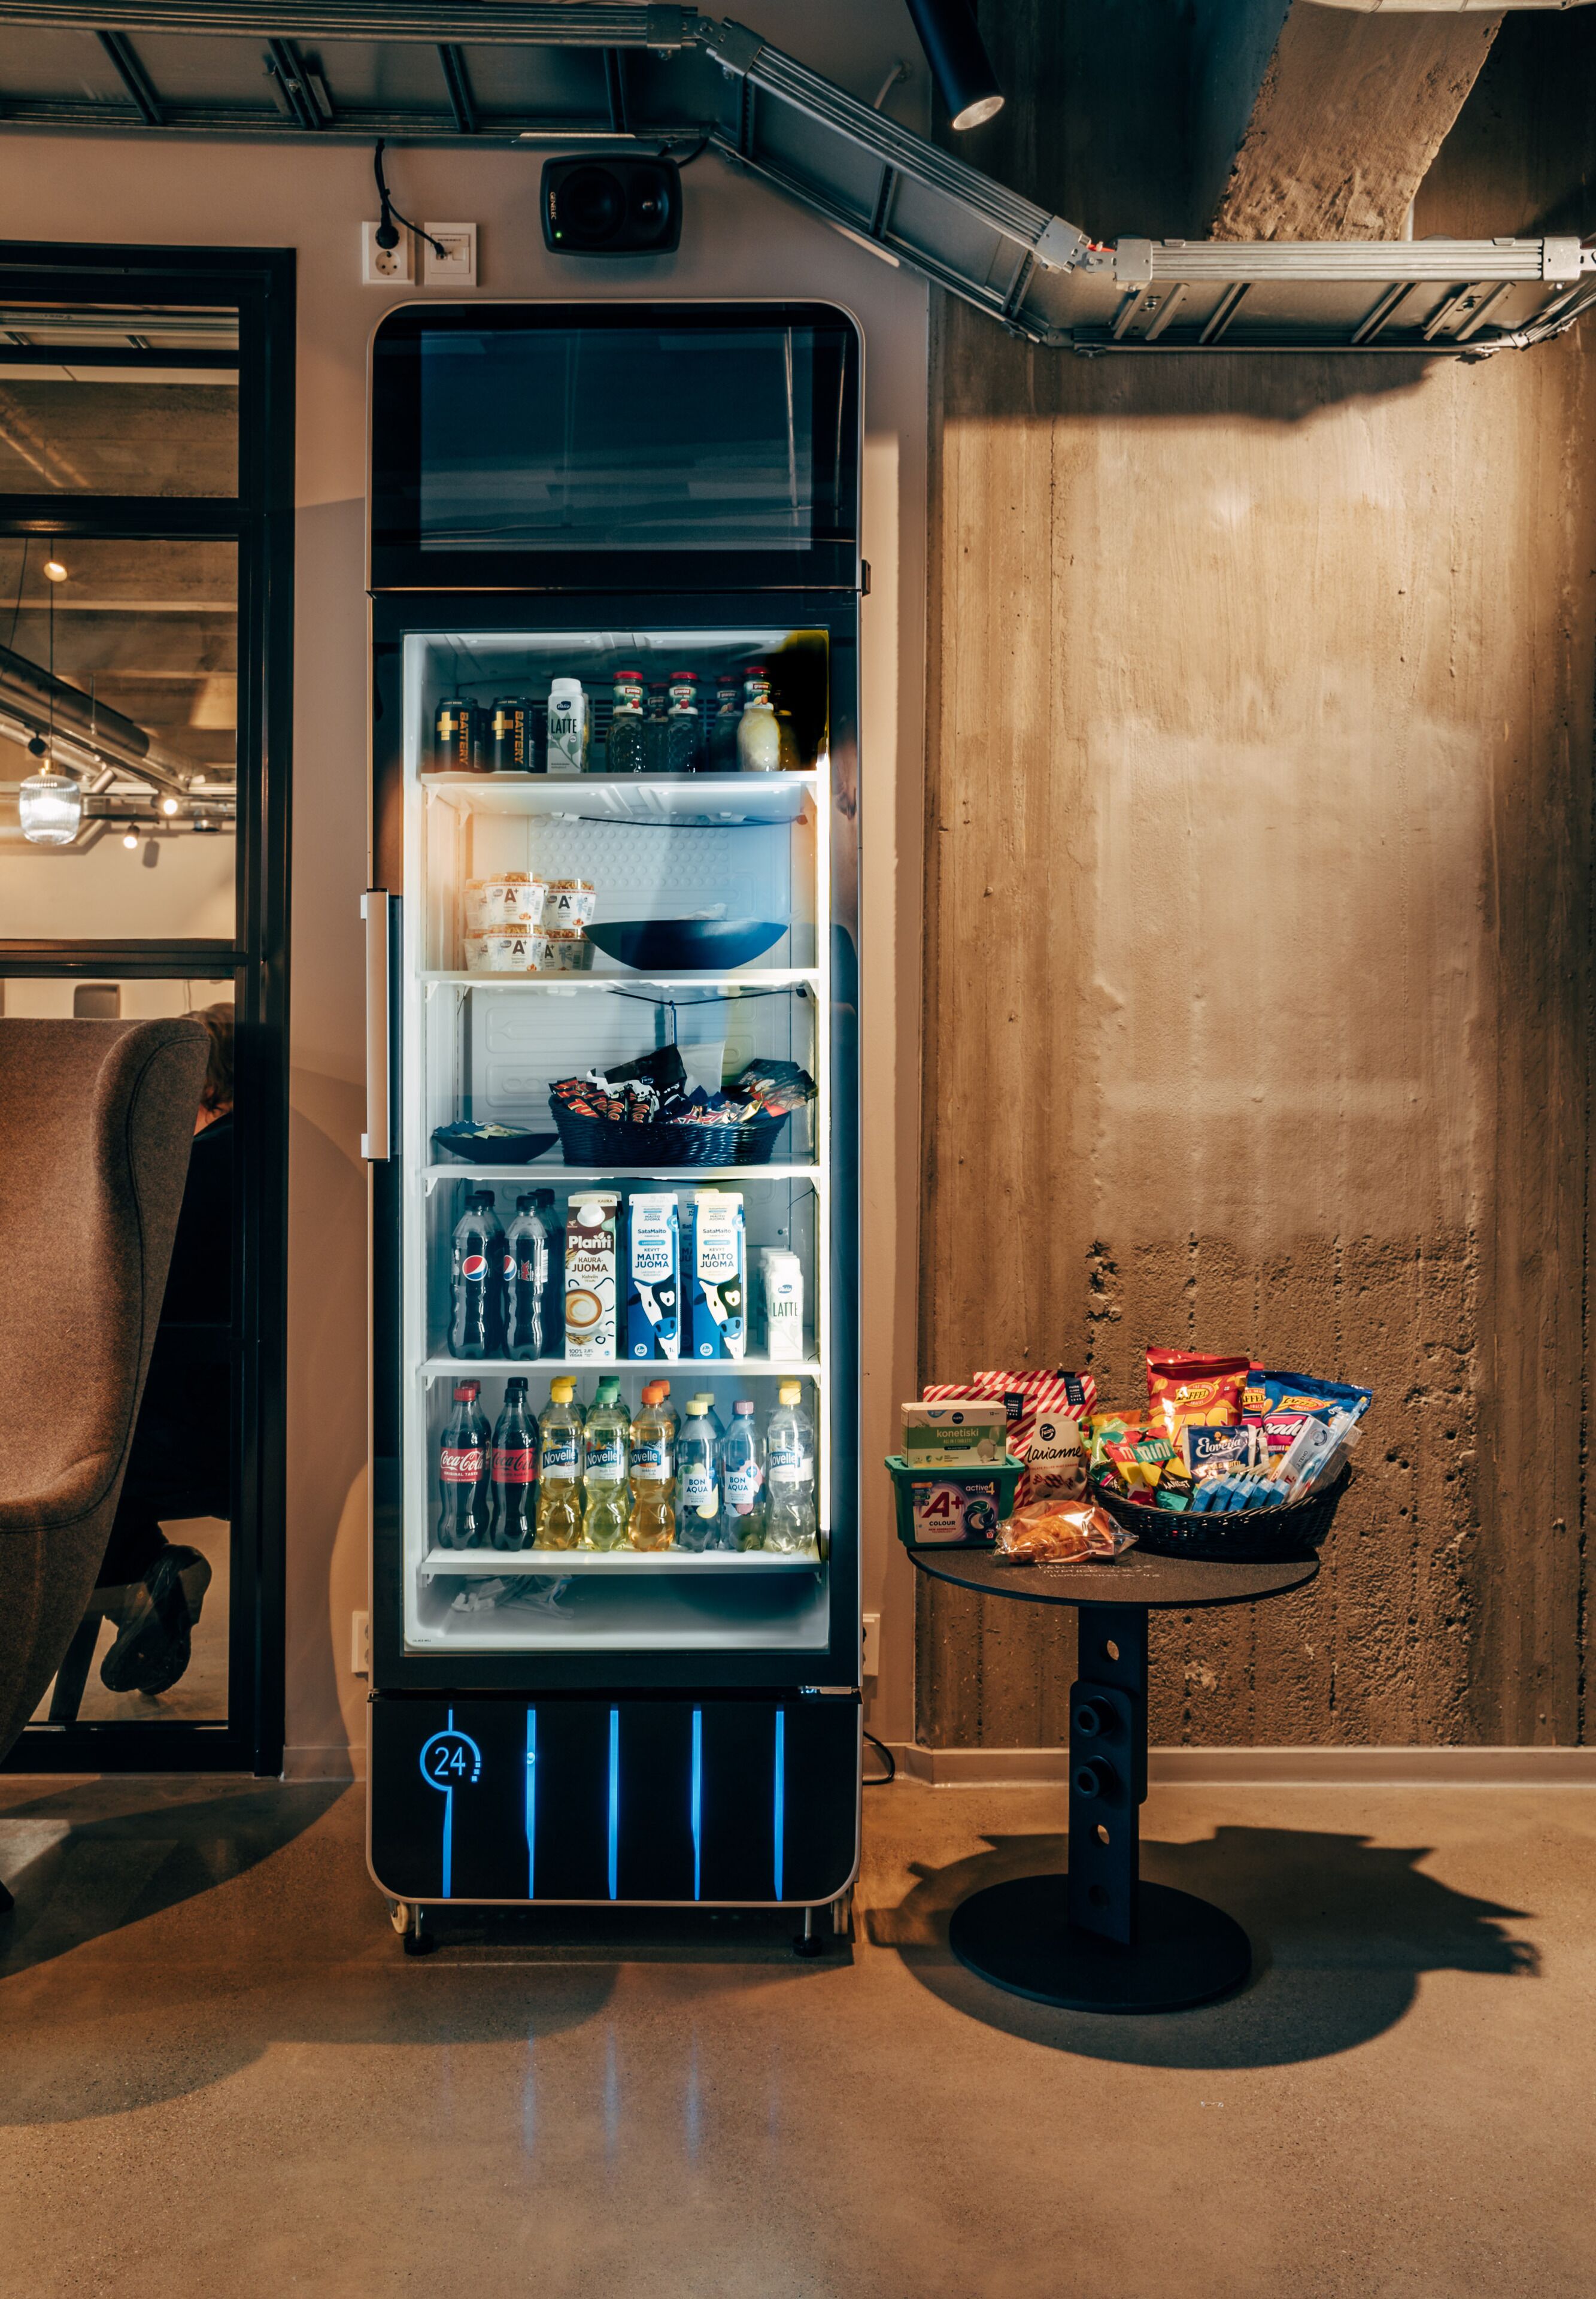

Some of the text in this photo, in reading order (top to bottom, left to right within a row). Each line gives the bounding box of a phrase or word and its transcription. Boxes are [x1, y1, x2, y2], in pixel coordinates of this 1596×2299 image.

[551, 719, 576, 733] LATTE
[459, 711, 469, 765] BATTERY
[515, 711, 524, 764] BATTERY
[569, 1234, 611, 1248] Planti
[773, 1302, 797, 1317] LATTE
[937, 1428, 979, 1437] konetiski
[441, 1450, 484, 1471] Coca-Cola
[544, 1449, 575, 1466] Novelle
[587, 1451, 617, 1467] Novelle
[1137, 1442, 1171, 1461] mini
[921, 1491, 964, 1518] A+
[435, 1746, 466, 1776] 24
